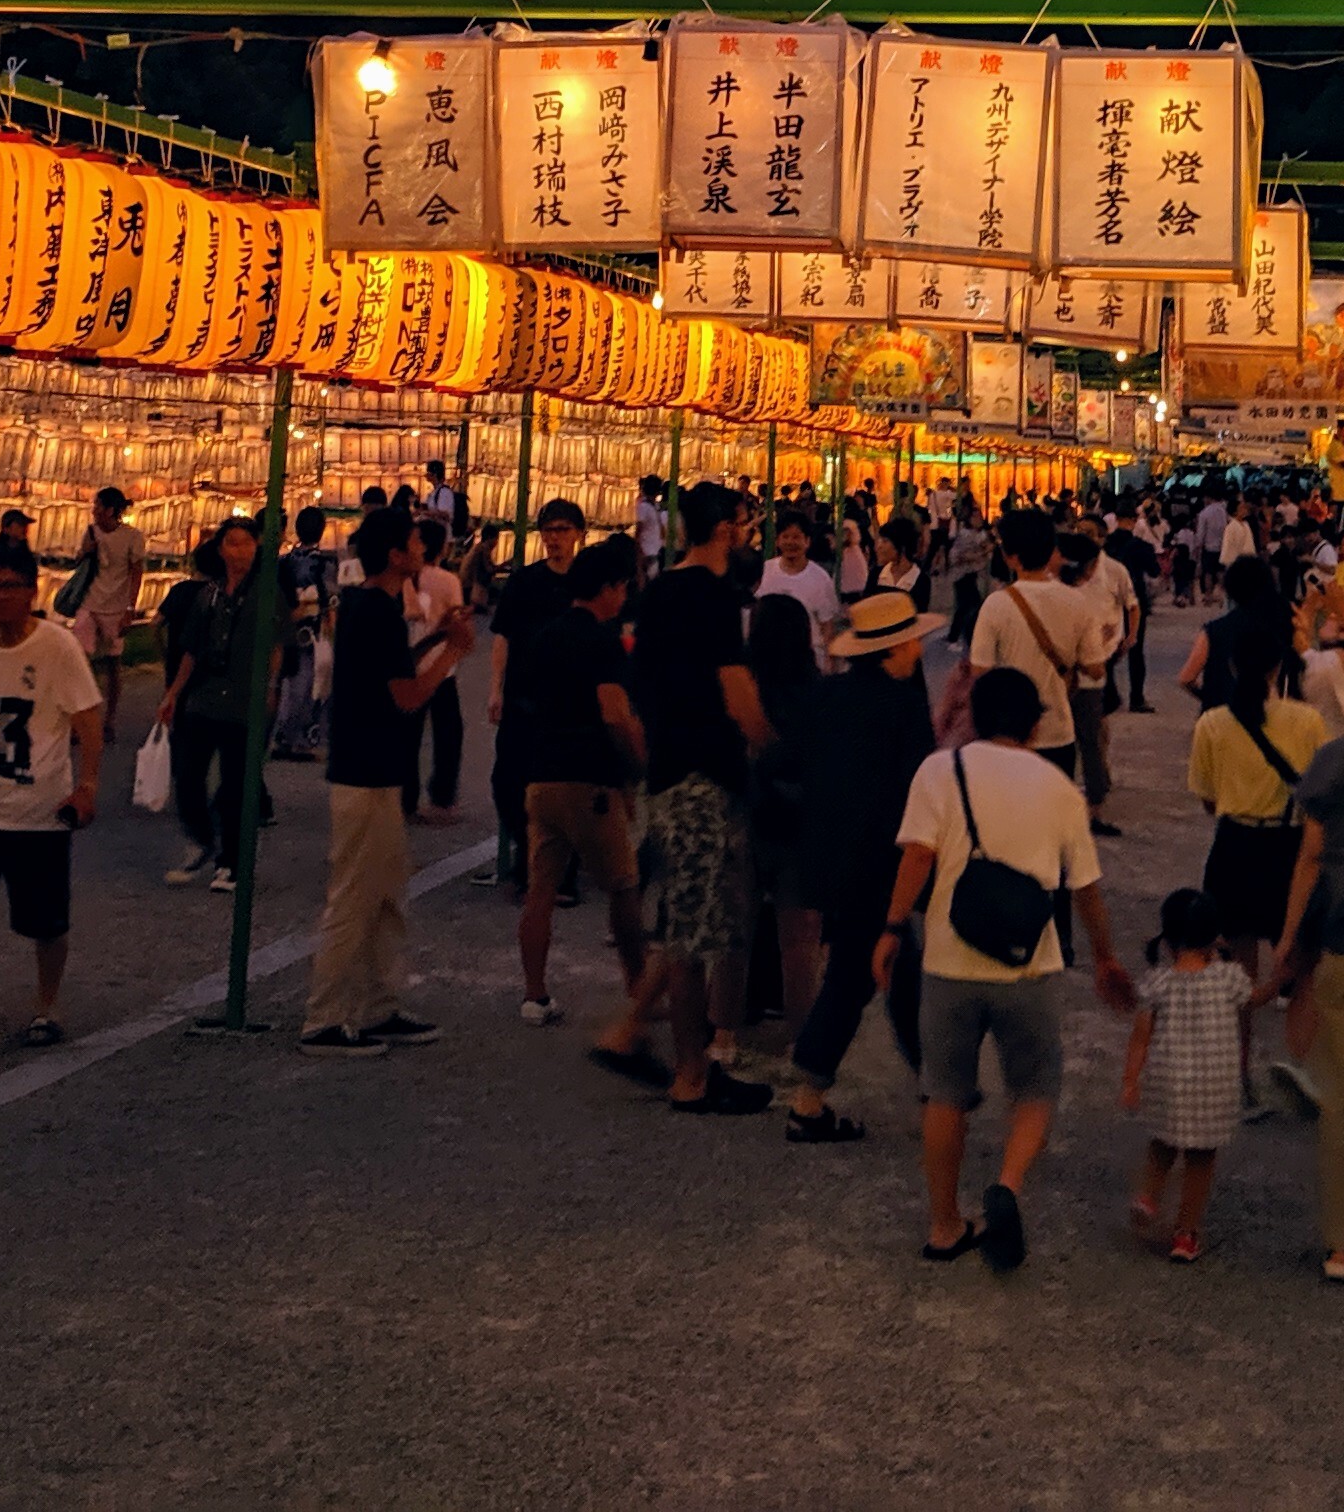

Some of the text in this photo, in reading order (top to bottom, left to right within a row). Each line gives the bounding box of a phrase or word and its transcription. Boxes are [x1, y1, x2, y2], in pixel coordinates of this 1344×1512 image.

[358, 89, 388, 226] PICFA
[417, 85, 460, 226] 恵風会
[531, 90, 571, 228] 西村瑞枝
[698, 71, 741, 214] 井上渓泉
[766, 72, 808, 217] 半田龍玄
[899, 77, 930, 238] アトリエ・ブラヴォ
[976, 82, 1014, 249] 九州デザイナー学院
[1093, 99, 1135, 246] 揮毫者芳名
[1156, 99, 1204, 237] 献燈絵
